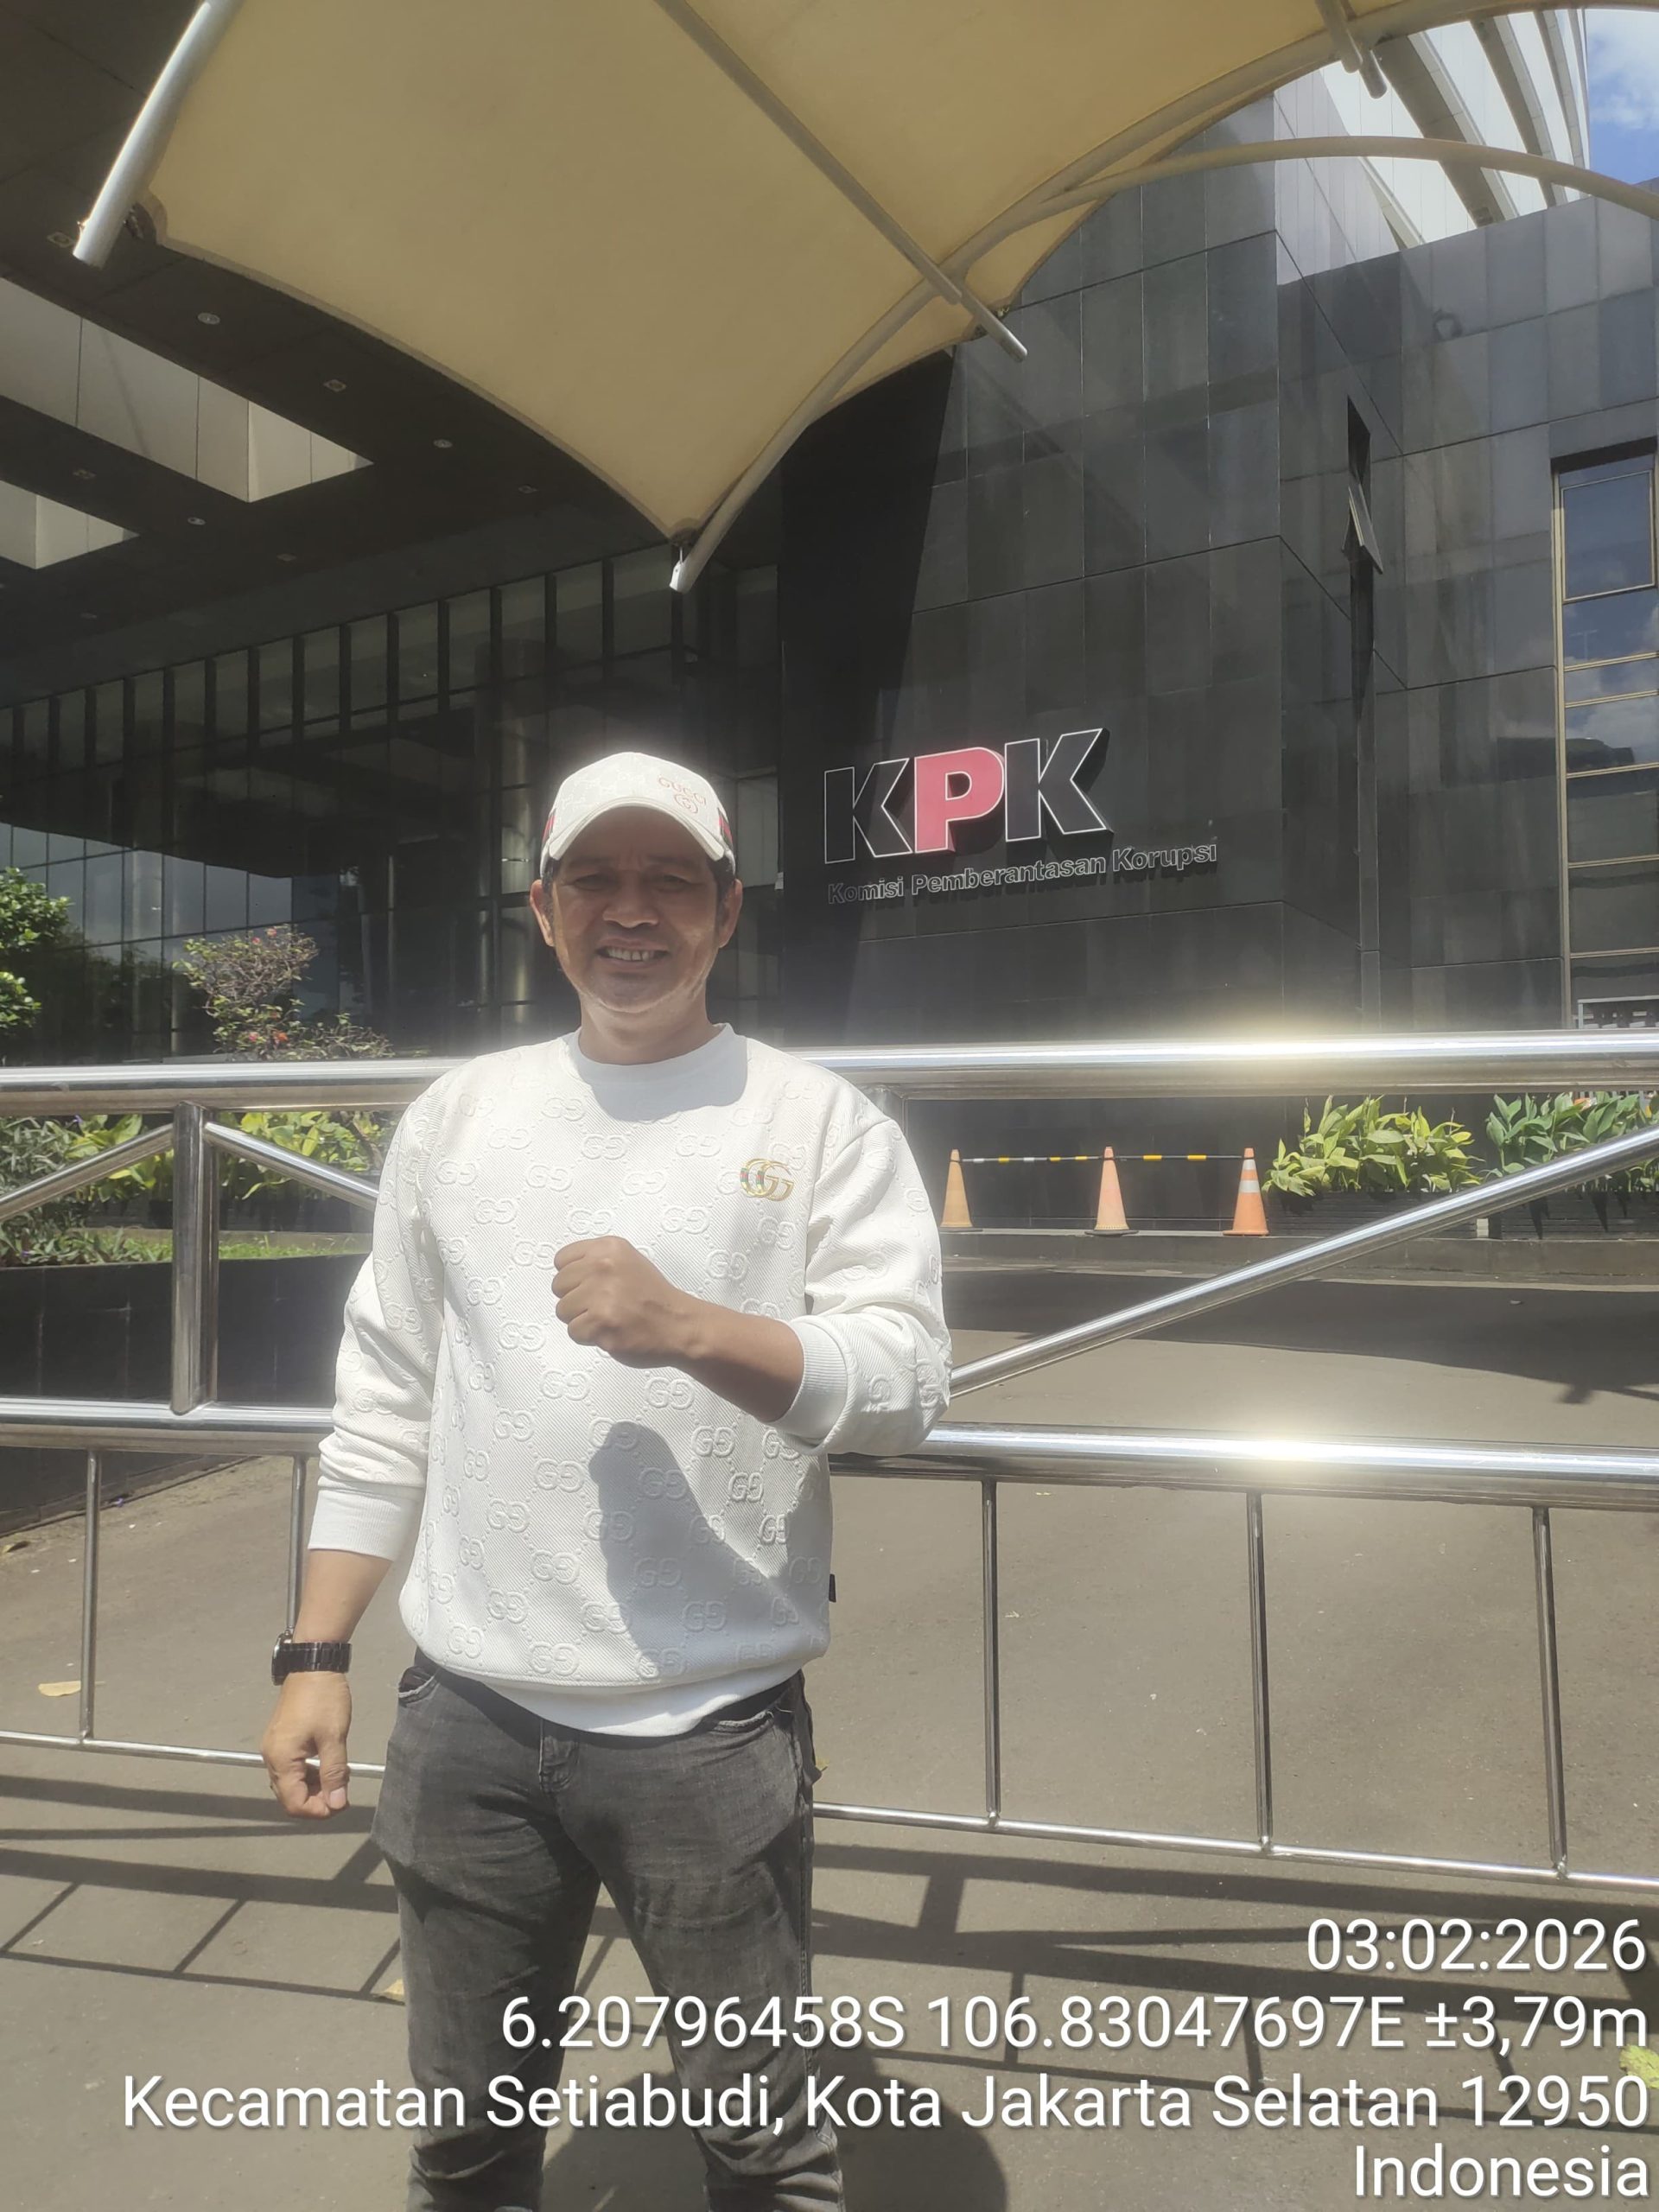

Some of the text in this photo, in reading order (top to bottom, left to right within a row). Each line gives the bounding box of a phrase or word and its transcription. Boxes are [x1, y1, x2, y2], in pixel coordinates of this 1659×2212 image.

[824, 728, 1109, 864] KPK
[828, 836, 1218, 904] Komisi Pemberantasan Korupsi
